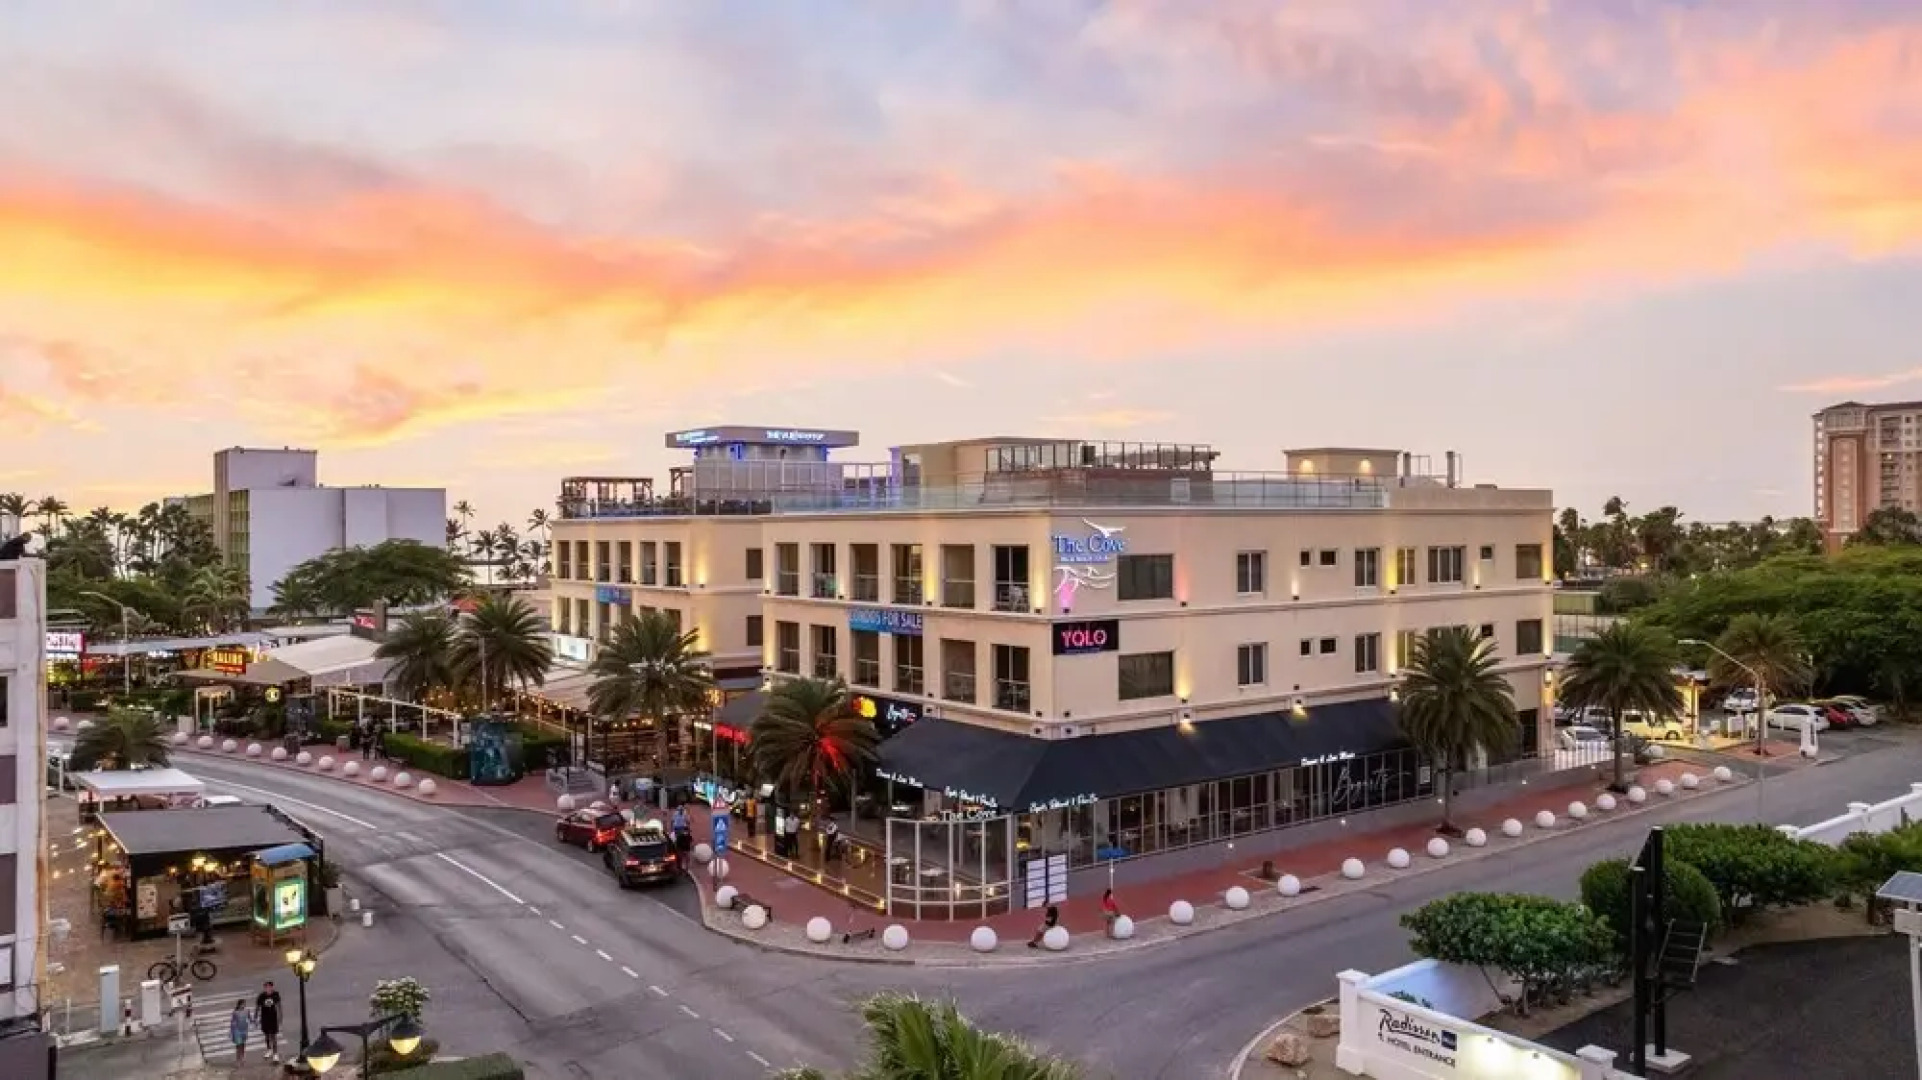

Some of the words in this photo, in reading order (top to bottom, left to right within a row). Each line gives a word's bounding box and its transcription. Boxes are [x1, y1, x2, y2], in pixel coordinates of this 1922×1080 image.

[1052, 534, 1083, 553] The
[1088, 533, 1125, 553] Cove
[901, 612, 922, 629] SALE
[1062, 629, 1107, 648] YOLO
[1387, 1037, 1411, 1052] HOTEL
[1413, 1044, 1456, 1068] ENTRANCE
